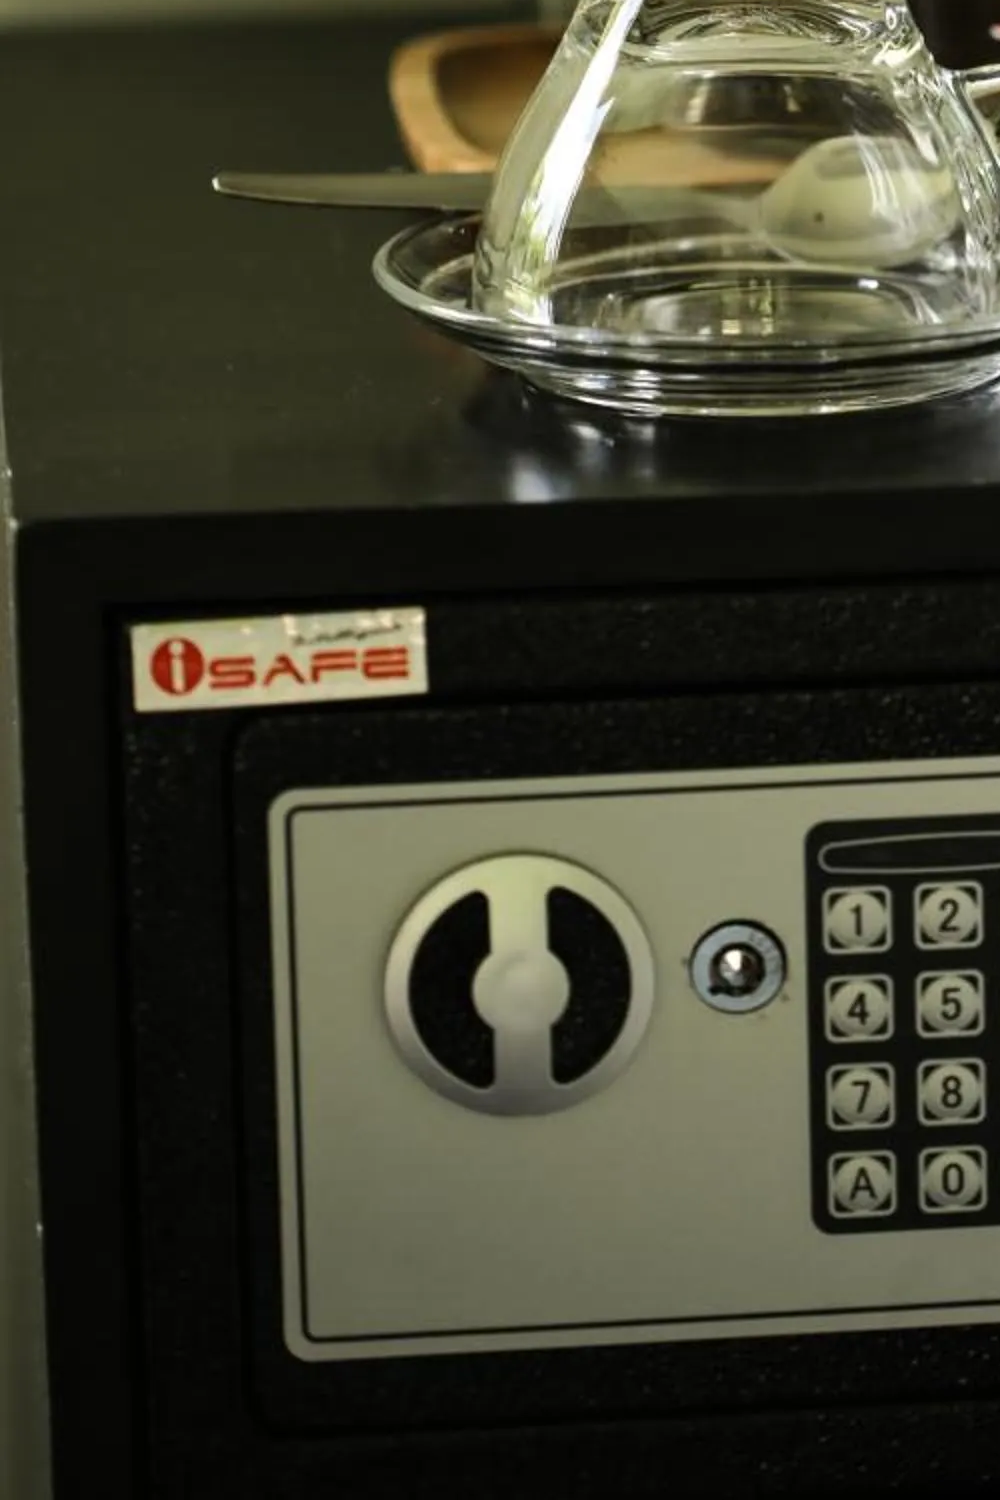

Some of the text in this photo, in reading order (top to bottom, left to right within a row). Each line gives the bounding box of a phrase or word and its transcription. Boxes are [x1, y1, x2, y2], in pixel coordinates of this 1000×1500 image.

[849, 903, 864, 936] 1
[938, 898, 961, 932] 2
[847, 992, 869, 1025] 4
[941, 987, 961, 1020] 5
[851, 1080, 871, 1113] 7
[941, 1075, 963, 1109] 8
[849, 1166, 877, 1200] A
[942, 1162, 965, 1196] 0
